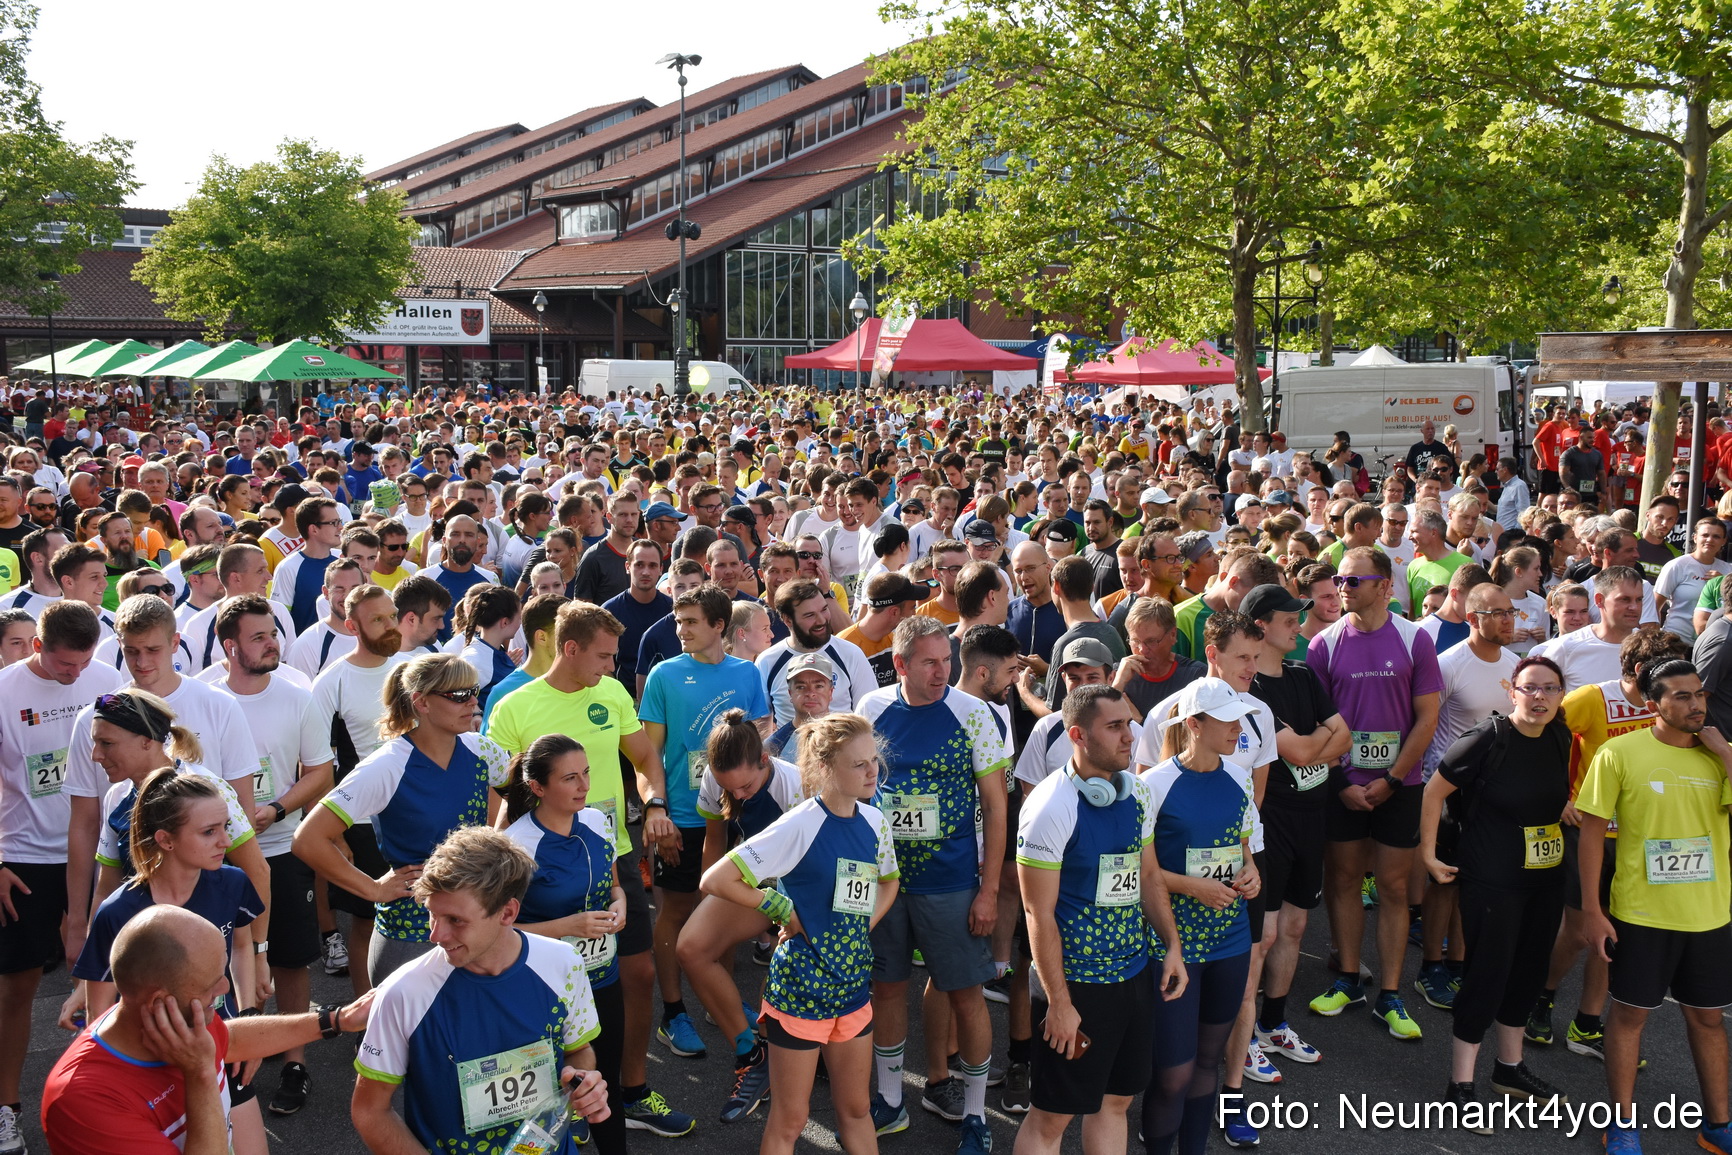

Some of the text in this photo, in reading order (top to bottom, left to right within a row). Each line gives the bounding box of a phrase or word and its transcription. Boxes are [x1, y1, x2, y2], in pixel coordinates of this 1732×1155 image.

[395, 305, 452, 318] Hallen
[1433, 414, 1451, 422] AUS!
[689, 689, 736, 732] Team Schick Bau
[1607, 725, 1636, 738] MAX
[1360, 745, 1389, 758] 900
[37, 763, 67, 786] 21
[892, 811, 923, 827] 241
[1533, 838, 1561, 856] 1976
[1655, 853, 1704, 871] 1277
[1200, 863, 1234, 881] 244
[847, 879, 870, 901] 191
[1111, 871, 1137, 892] 245
[576, 934, 607, 957] 272
[484, 1071, 538, 1107] 192
[487, 1095, 539, 1116] Albrecht Peter
